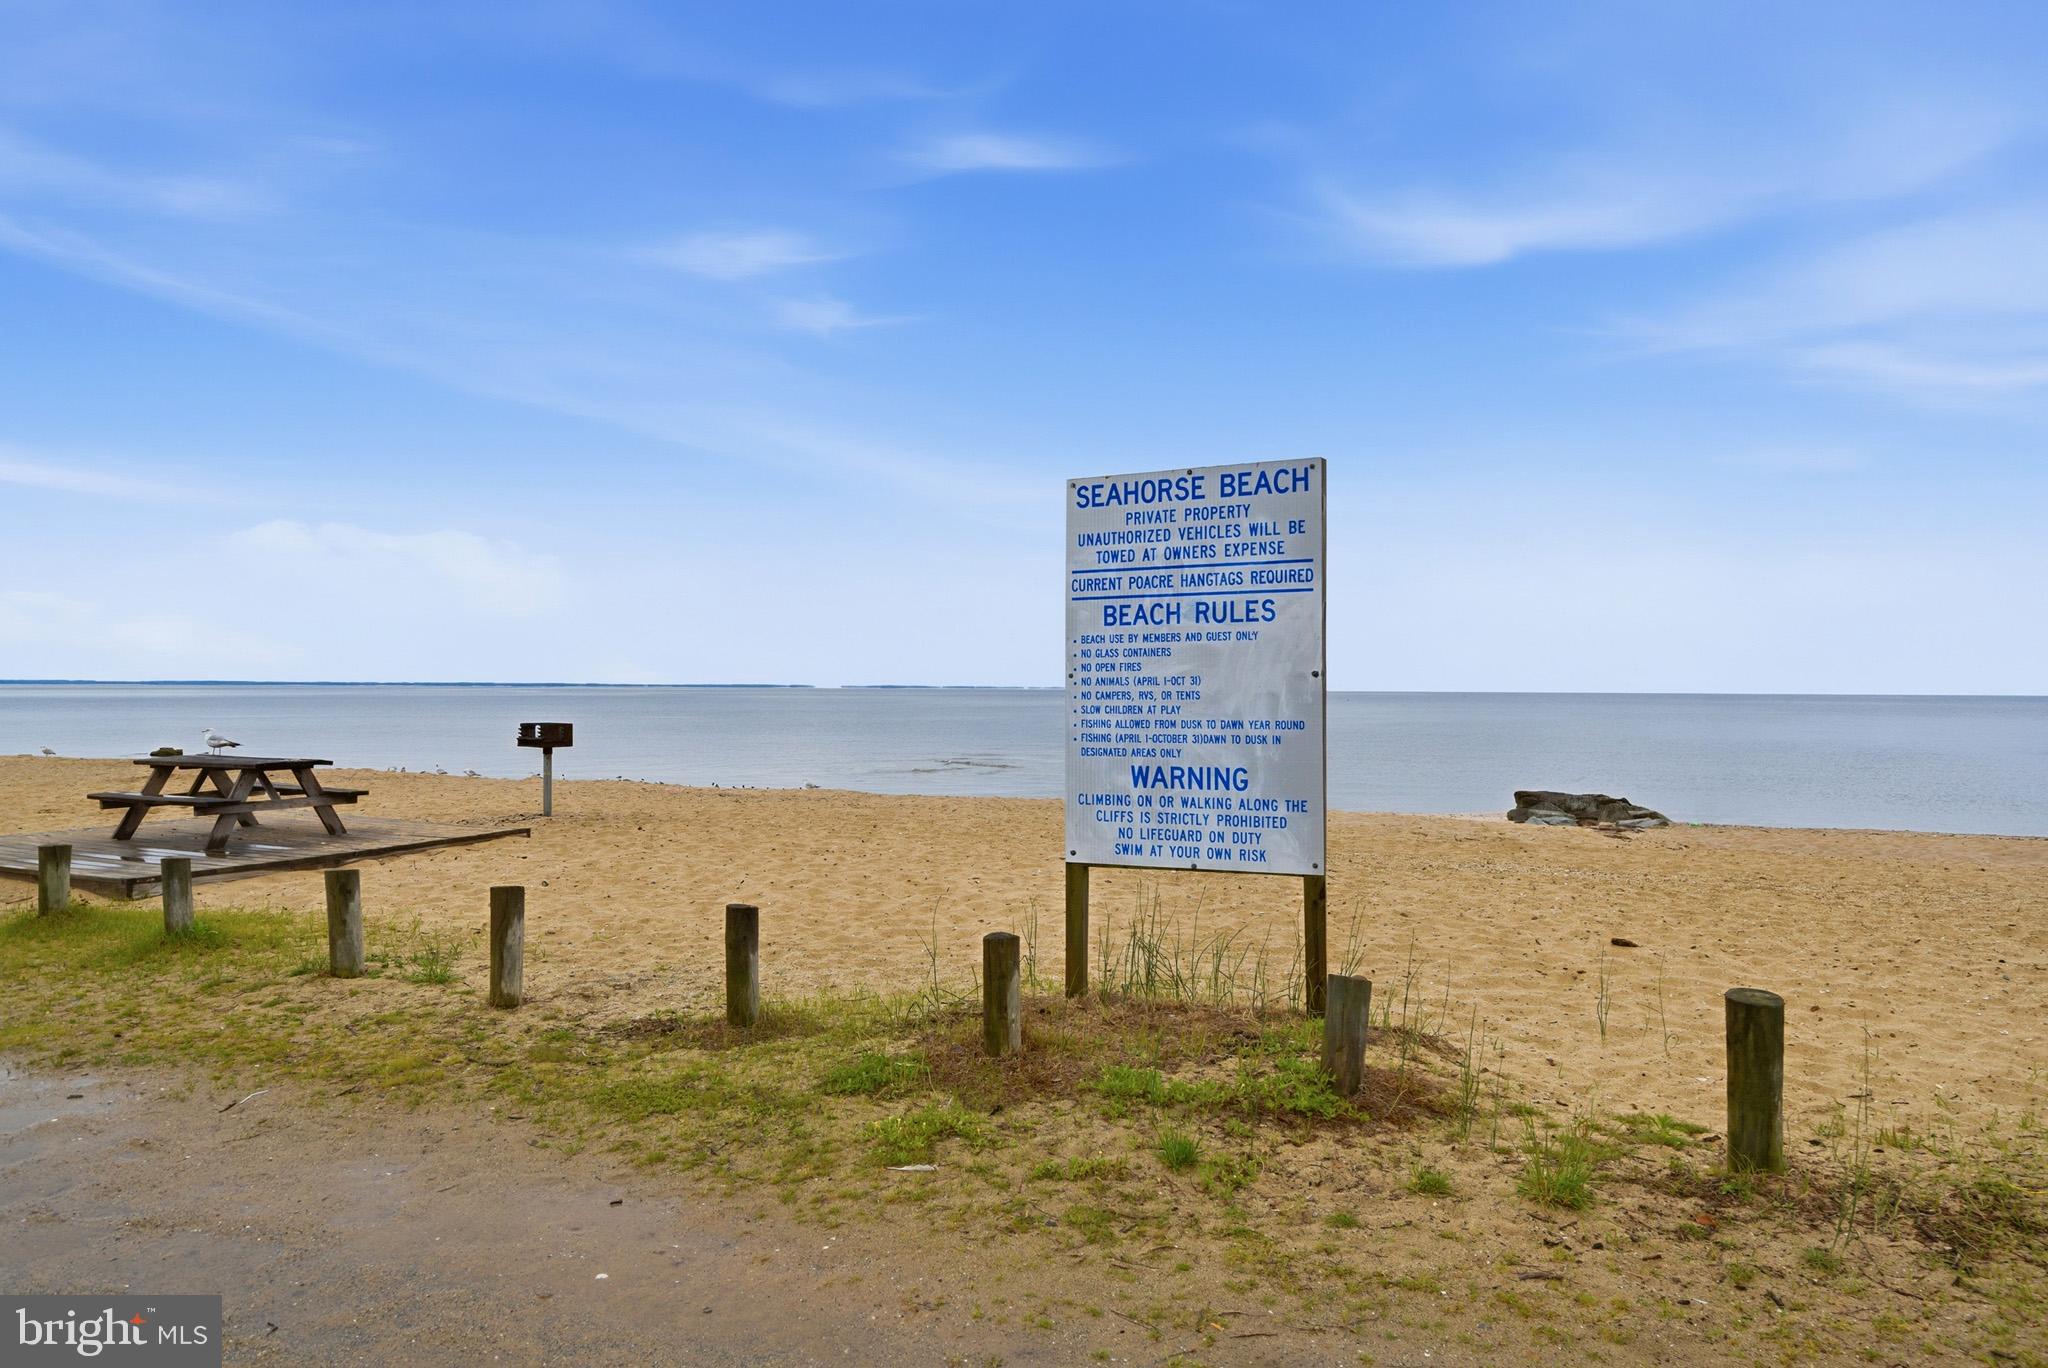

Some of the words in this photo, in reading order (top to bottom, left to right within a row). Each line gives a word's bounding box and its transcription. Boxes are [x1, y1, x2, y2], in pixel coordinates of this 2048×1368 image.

[1076, 475, 1206, 509] SEAHORSE
[1219, 466, 1310, 498] BEACH
[1125, 509, 1177, 526] PRIVATE
[1184, 503, 1251, 522] PROPERTY
[1078, 528, 1171, 547] UNAUTHORIZED
[1178, 524, 1241, 541] VEHICLES
[1248, 521, 1280, 537] WILL
[1289, 520, 1306, 534] BE
[1095, 549, 1136, 564] TOWED
[1142, 547, 1156, 561] AT
[1163, 544, 1217, 561] OWNERS
[1224, 541, 1285, 557] EXPENSE
[1071, 576, 1123, 593] CURRENT
[1128, 574, 1174, 590] POACRE
[1180, 571, 1244, 588] HANGTAGS
[1250, 568, 1314, 585] REQUIRED
[1103, 602, 1182, 627] BEACH
[1195, 598, 1276, 624] RULES
[1080, 634, 1106, 644] BEACH
[1109, 634, 1124, 644] USE
[1128, 633, 1139, 643] BY
[1142, 633, 1181, 643] MEMBERS
[1185, 632, 1202, 642] AND
[1205, 631, 1232, 642] GUEST
[1235, 630, 1259, 641] ONLY
[1080, 649, 1092, 658] NO
[1095, 648, 1120, 658] GLASS
[1122, 647, 1172, 658] CONTAINERS
[1080, 663, 1092, 672] NO
[1095, 662, 1116, 672] OPEN
[1119, 662, 1142, 672] FIRES
[1080, 677, 1092, 686] NO
[1095, 676, 1130, 686] ANIMALS
[1133, 676, 1160, 687] (APRIL
[1163, 676, 1186, 686] 1-OCT
[1189, 676, 1201, 686] 31)
[1080, 691, 1092, 700] NO
[1095, 690, 1135, 702] CAMPERS,
[1138, 690, 1157, 701] RVS,
[1161, 690, 1172, 700] OR
[1176, 690, 1201, 700] TENTS
[1080, 705, 1101, 715] SLOW
[1104, 705, 1143, 715] CHILDREN
[1147, 705, 1157, 715] AT
[1160, 705, 1181, 715] PLAY
[1080, 719, 1112, 729] FISHING
[1114, 719, 1151, 729] ALLOWED
[1154, 719, 1177, 729] FROM
[1180, 719, 1202, 730] DUSK
[1206, 719, 1217, 730] TO
[1220, 720, 1244, 730] DAWN
[1248, 720, 1271, 730] YEAR
[1274, 720, 1305, 730] ROUND
[1080, 733, 1112, 743] FISHING
[1115, 733, 1142, 744] (APRIL
[1145, 733, 1188, 744] 1-OCTOBER
[1231, 734, 1241, 744] TO
[1245, 734, 1268, 745] DUSK
[1272, 735, 1281, 745] IN
[1080, 747, 1127, 758] DESIGNATED
[1130, 747, 1156, 758] AREAS
[1160, 748, 1182, 758] ONLY
[1131, 764, 1249, 792] WARNING
[1078, 793, 1131, 807] CLIMBING
[1137, 794, 1152, 808] ON
[1159, 795, 1174, 808] OR
[1180, 796, 1232, 810] WALKING
[1238, 798, 1278, 812] ALONG
[1285, 799, 1308, 813] THE
[1096, 810, 1134, 824] CLIFFS
[1140, 811, 1151, 824] IS
[1157, 812, 1209, 827] STRICTLY
[1216, 814, 1288, 830] PROHIBITED
[1118, 826, 1133, 840] NO
[1139, 827, 1202, 842] LIFEGUARD
[1208, 830, 1225, 843] ON
[1232, 831, 1262, 845] DUTY
[1114, 843, 1143, 857] SWIM
[1150, 845, 1164, 857] AT
[1169, 845, 1200, 859] YOUR
[1206, 847, 1232, 861] OWN
[1239, 848, 1267, 863] RISK
